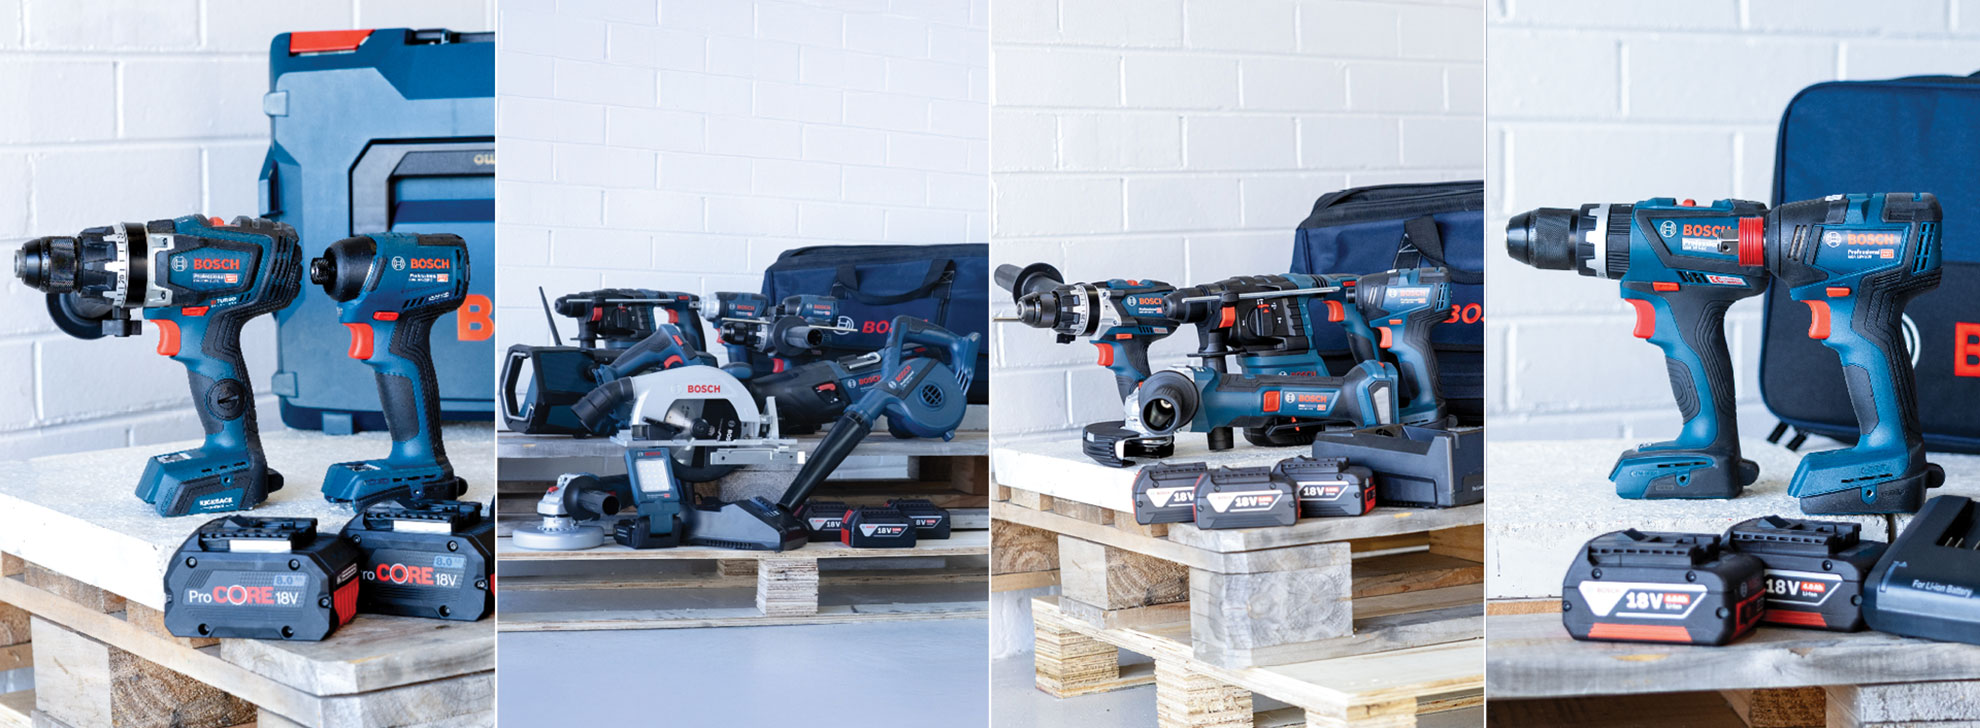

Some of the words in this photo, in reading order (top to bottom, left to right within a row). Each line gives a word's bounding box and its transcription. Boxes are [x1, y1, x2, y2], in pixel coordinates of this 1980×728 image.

[1847, 233, 1894, 245] BOSCH
[193, 257, 240, 270] BOSCH
[410, 258, 450, 269] BOSCH
[688, 385, 721, 393] BOSCH
[1298, 394, 1328, 403] BOSCH
[1303, 486, 1325, 496] 18V
[1173, 492, 1194, 502] 18V
[1235, 496, 1257, 507] 18V
[1766, 578, 1800, 596] 18V
[1912, 579, 1926, 589] For
[1946, 584, 1974, 599] Battery
[1626, 591, 1664, 610] 18V
